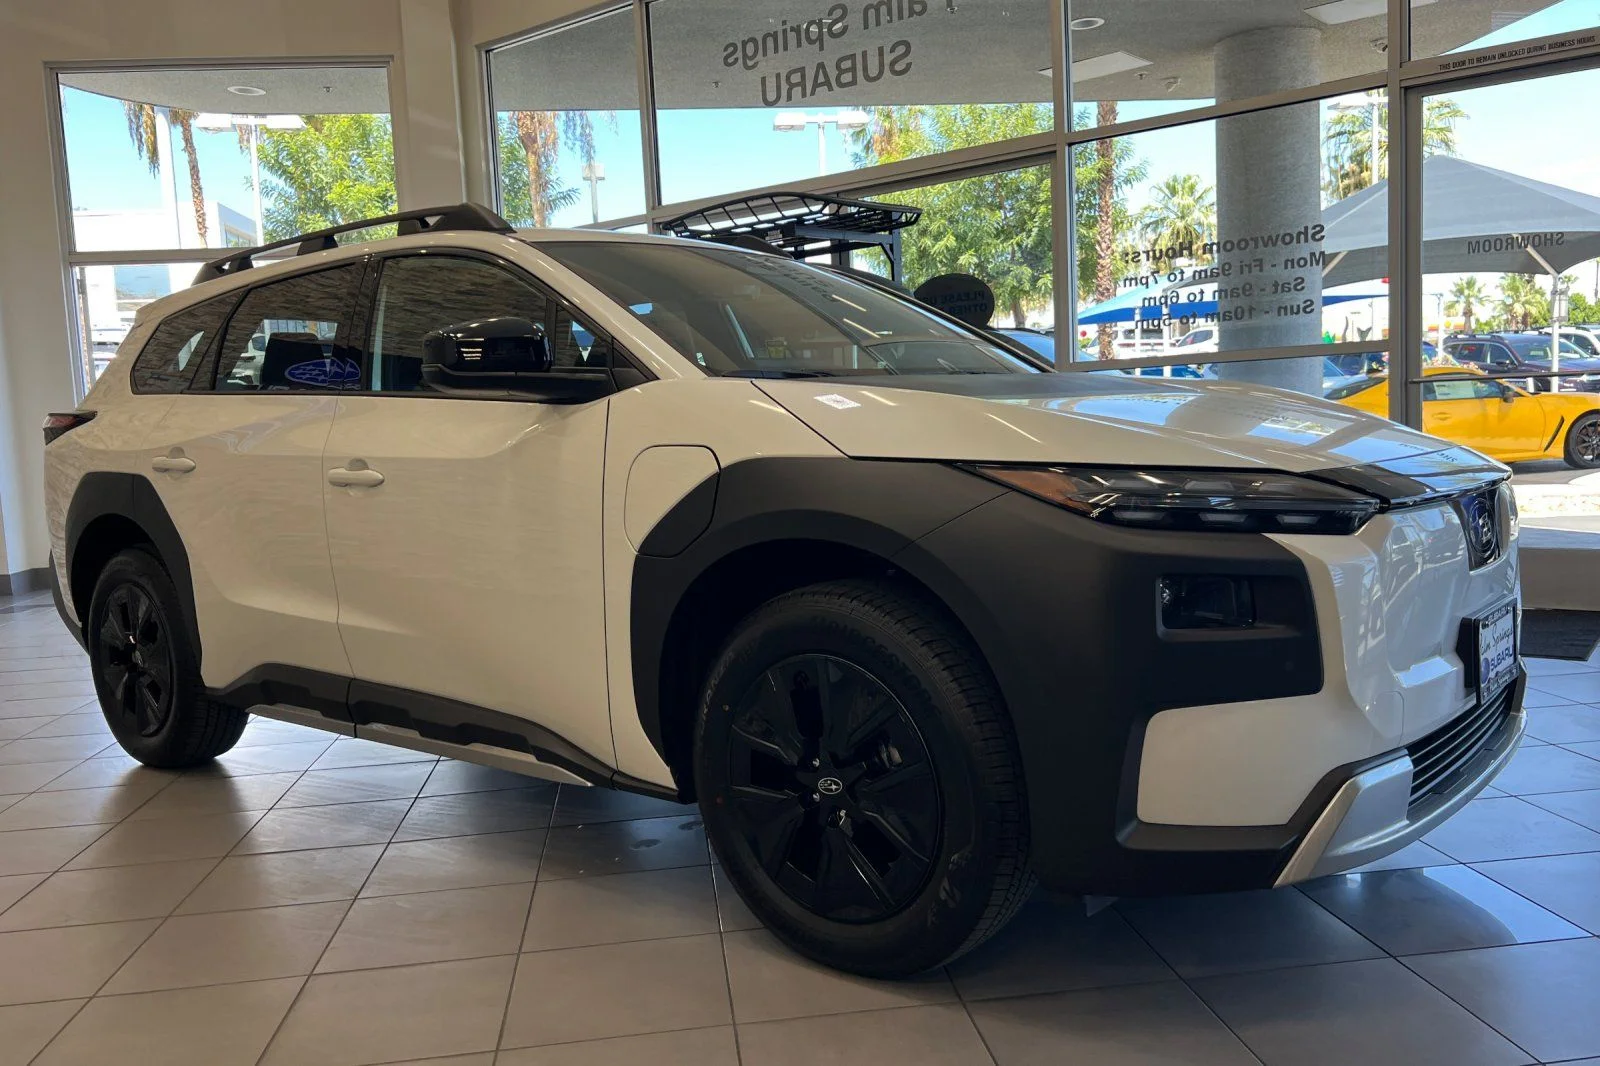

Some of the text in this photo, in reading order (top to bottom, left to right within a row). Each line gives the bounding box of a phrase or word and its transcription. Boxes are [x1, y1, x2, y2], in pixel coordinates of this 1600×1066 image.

[1439, 35, 1596, 71] THIS DOOR TO REMAIN UNLOCKED DURING BUSINESS HOURS
[1490, 646, 1514, 672] SUBARU
